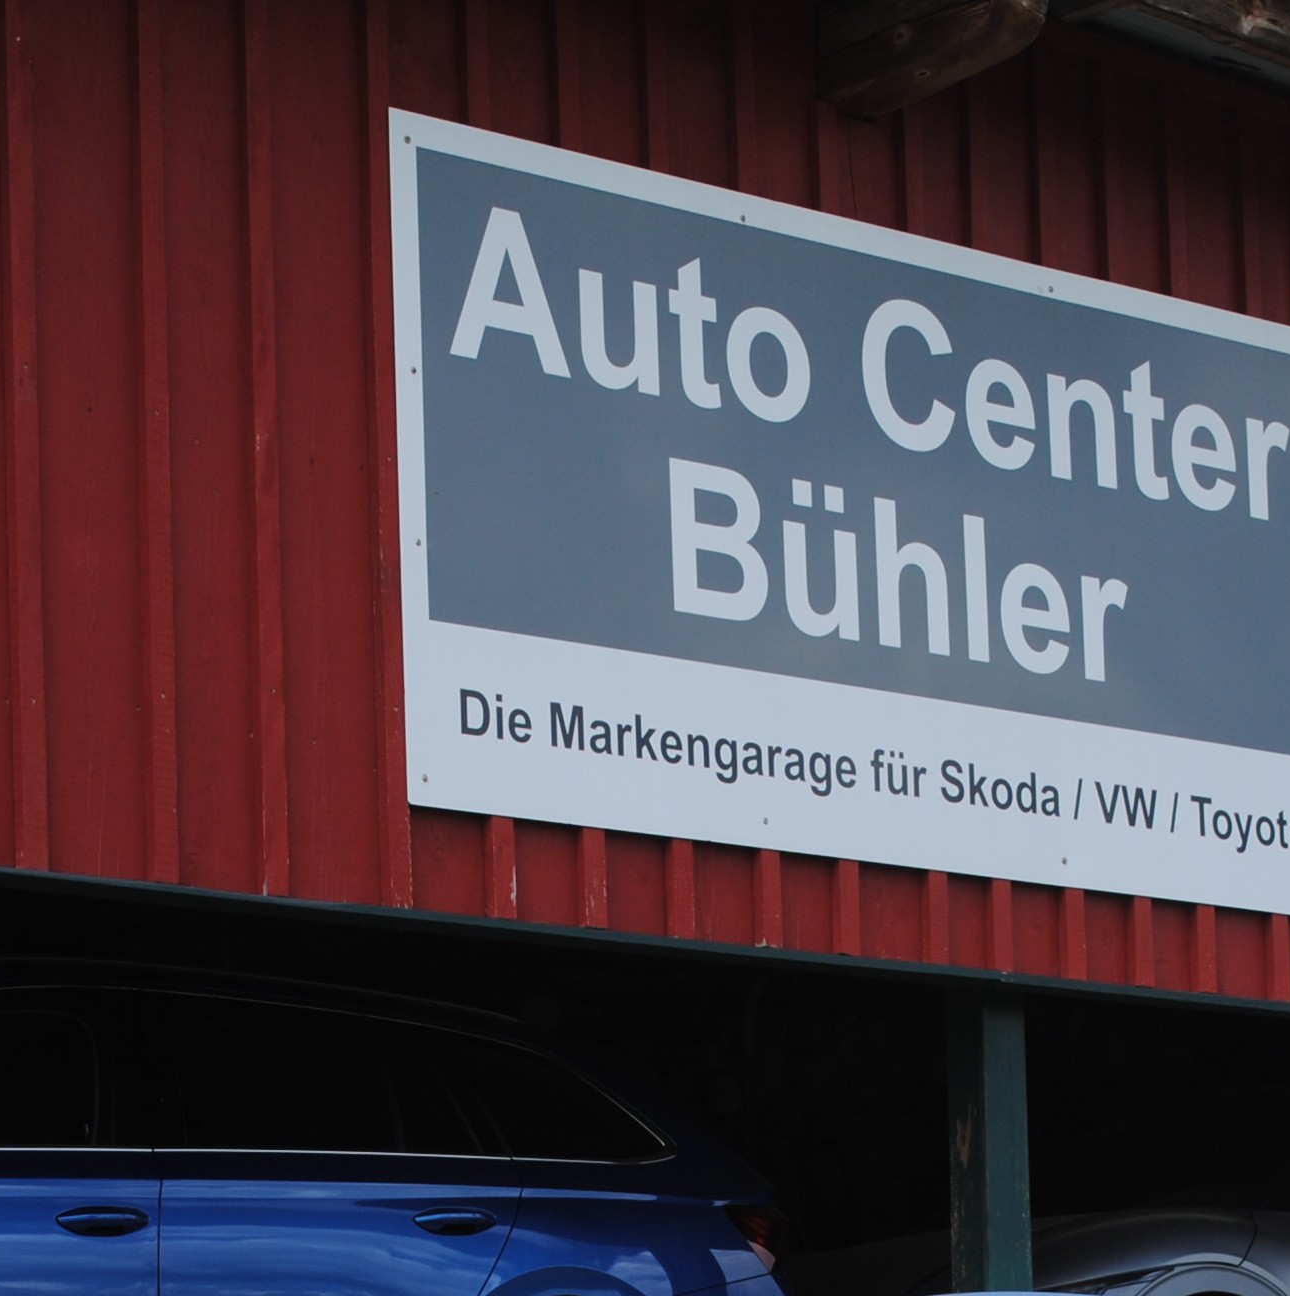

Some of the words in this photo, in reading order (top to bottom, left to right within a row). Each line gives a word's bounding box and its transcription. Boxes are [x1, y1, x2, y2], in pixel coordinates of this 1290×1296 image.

[449, 205, 812, 424] Auto
[861, 298, 1290, 521] Center
[668, 456, 1128, 683] Bühler
[457, 687, 533, 743] Die
[548, 701, 857, 797] Markengarage
[871, 749, 927, 800] für
[940, 759, 1062, 818] Skoda
[1073, 778, 1086, 821] /
[1094, 780, 1158, 830] VW
[1169, 792, 1180, 834] /
